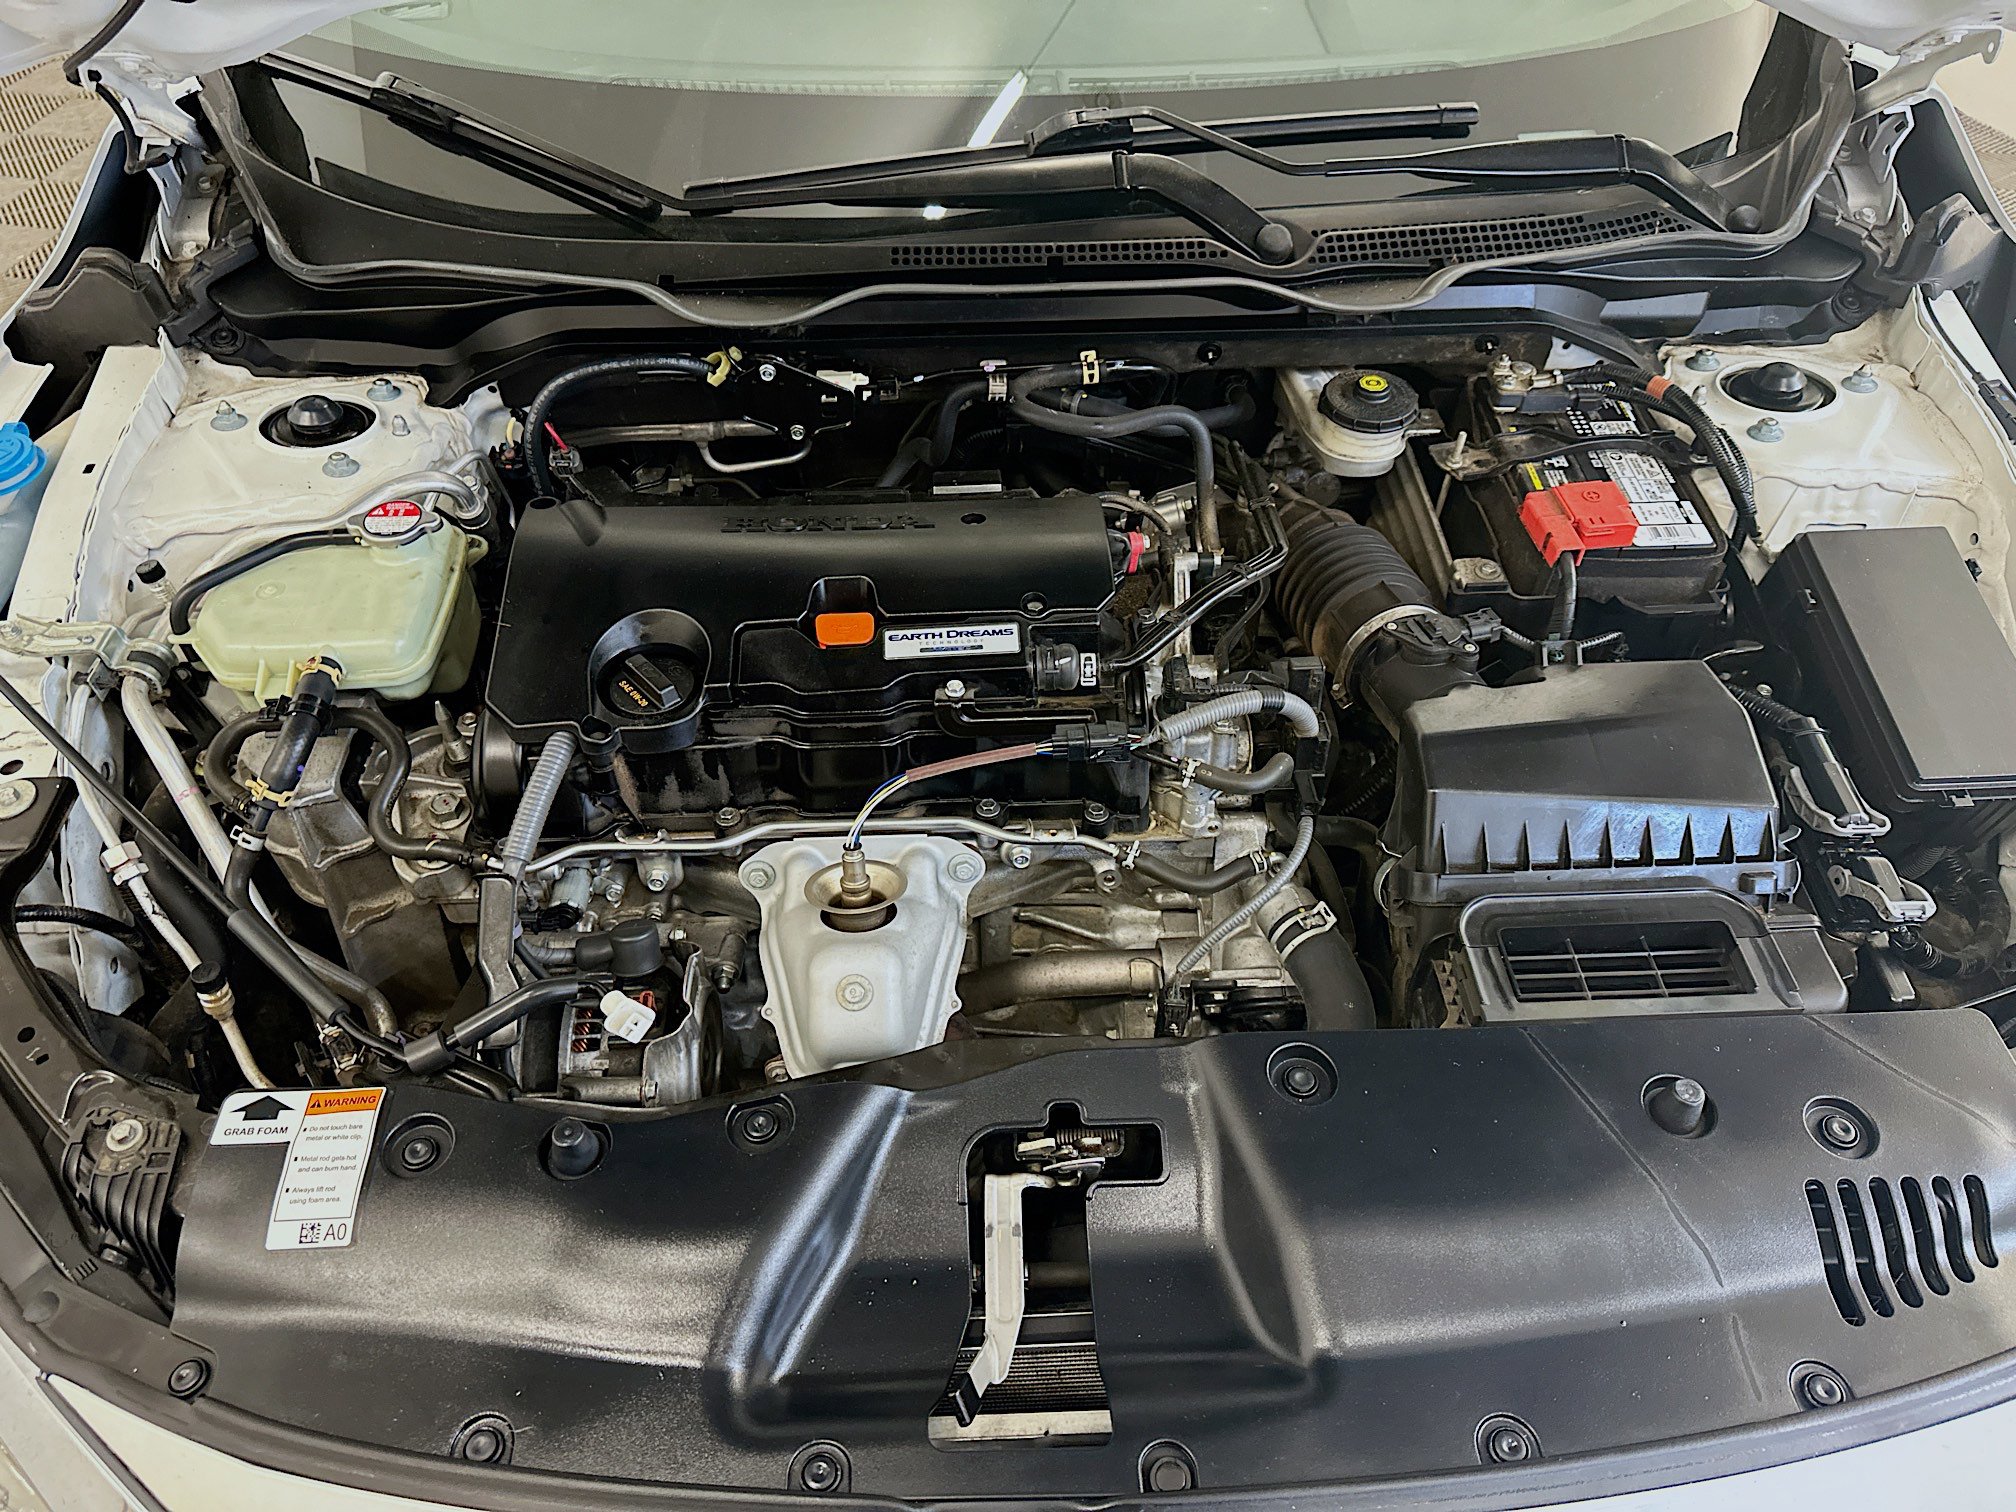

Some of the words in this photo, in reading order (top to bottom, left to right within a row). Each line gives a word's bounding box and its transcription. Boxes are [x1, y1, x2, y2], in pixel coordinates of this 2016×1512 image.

[720, 513, 936, 533] HONDA
[888, 632, 943, 642] EARTH
[946, 628, 1014, 639] DREAMS
[618, 680, 634, 693] SAE
[324, 1095, 377, 1107] WARNING
[224, 1127, 255, 1136] GRAB
[257, 1126, 289, 1135] FOAM
[323, 1222, 348, 1242] A0
